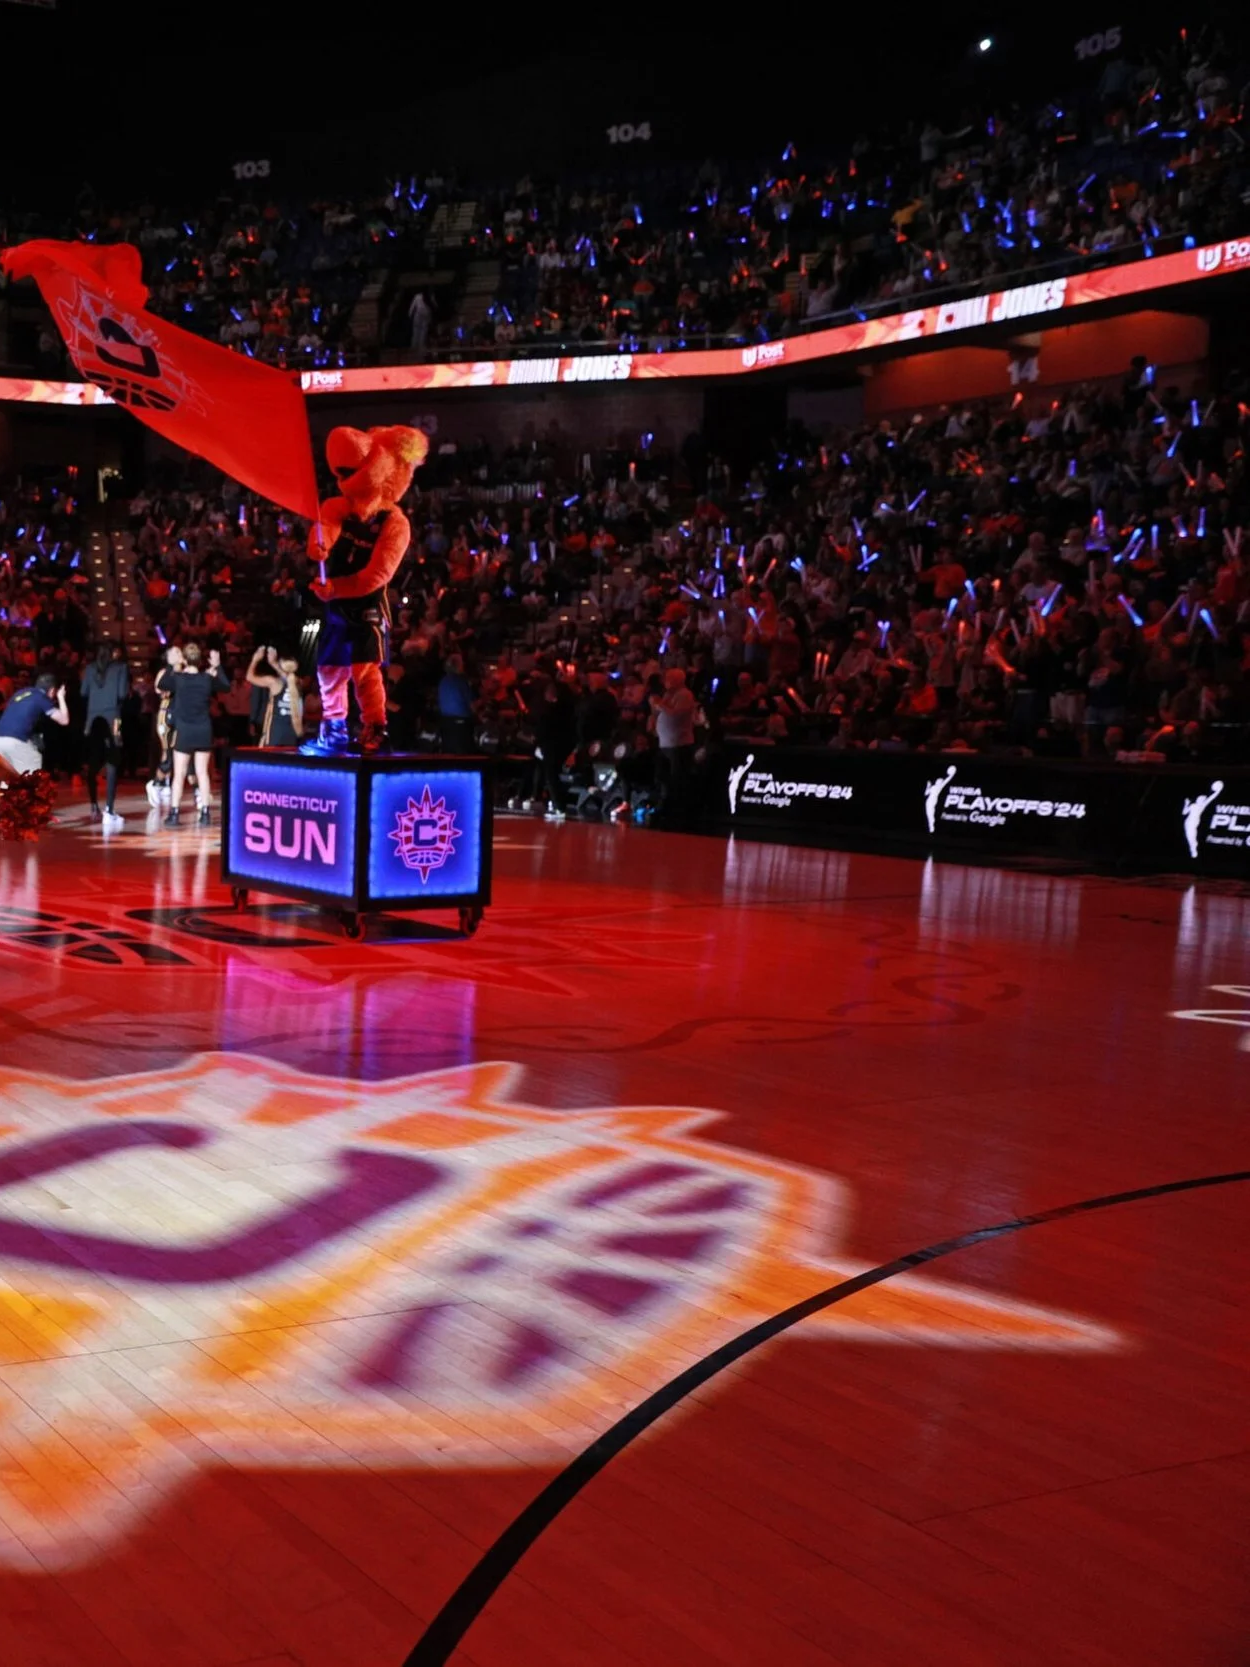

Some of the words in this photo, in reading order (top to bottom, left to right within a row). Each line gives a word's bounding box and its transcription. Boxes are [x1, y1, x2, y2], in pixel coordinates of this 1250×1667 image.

[1074, 26, 1122, 60] 105
[606, 121, 652, 144] 104
[231, 159, 271, 181] 103
[992, 277, 1067, 322] JONES
[311, 371, 343, 386] Post
[563, 354, 632, 382] JONES
[1006, 356, 1040, 386] 14
[244, 790, 338, 813] CONNECTICUT
[743, 780, 853, 800] PLAYOFFS'24
[762, 793, 792, 808] Google
[949, 786, 982, 796] WNBA
[944, 794, 1087, 819] PLAYOFFS'24
[969, 811, 1007, 827] Google
[244, 812, 336, 865] SUN
